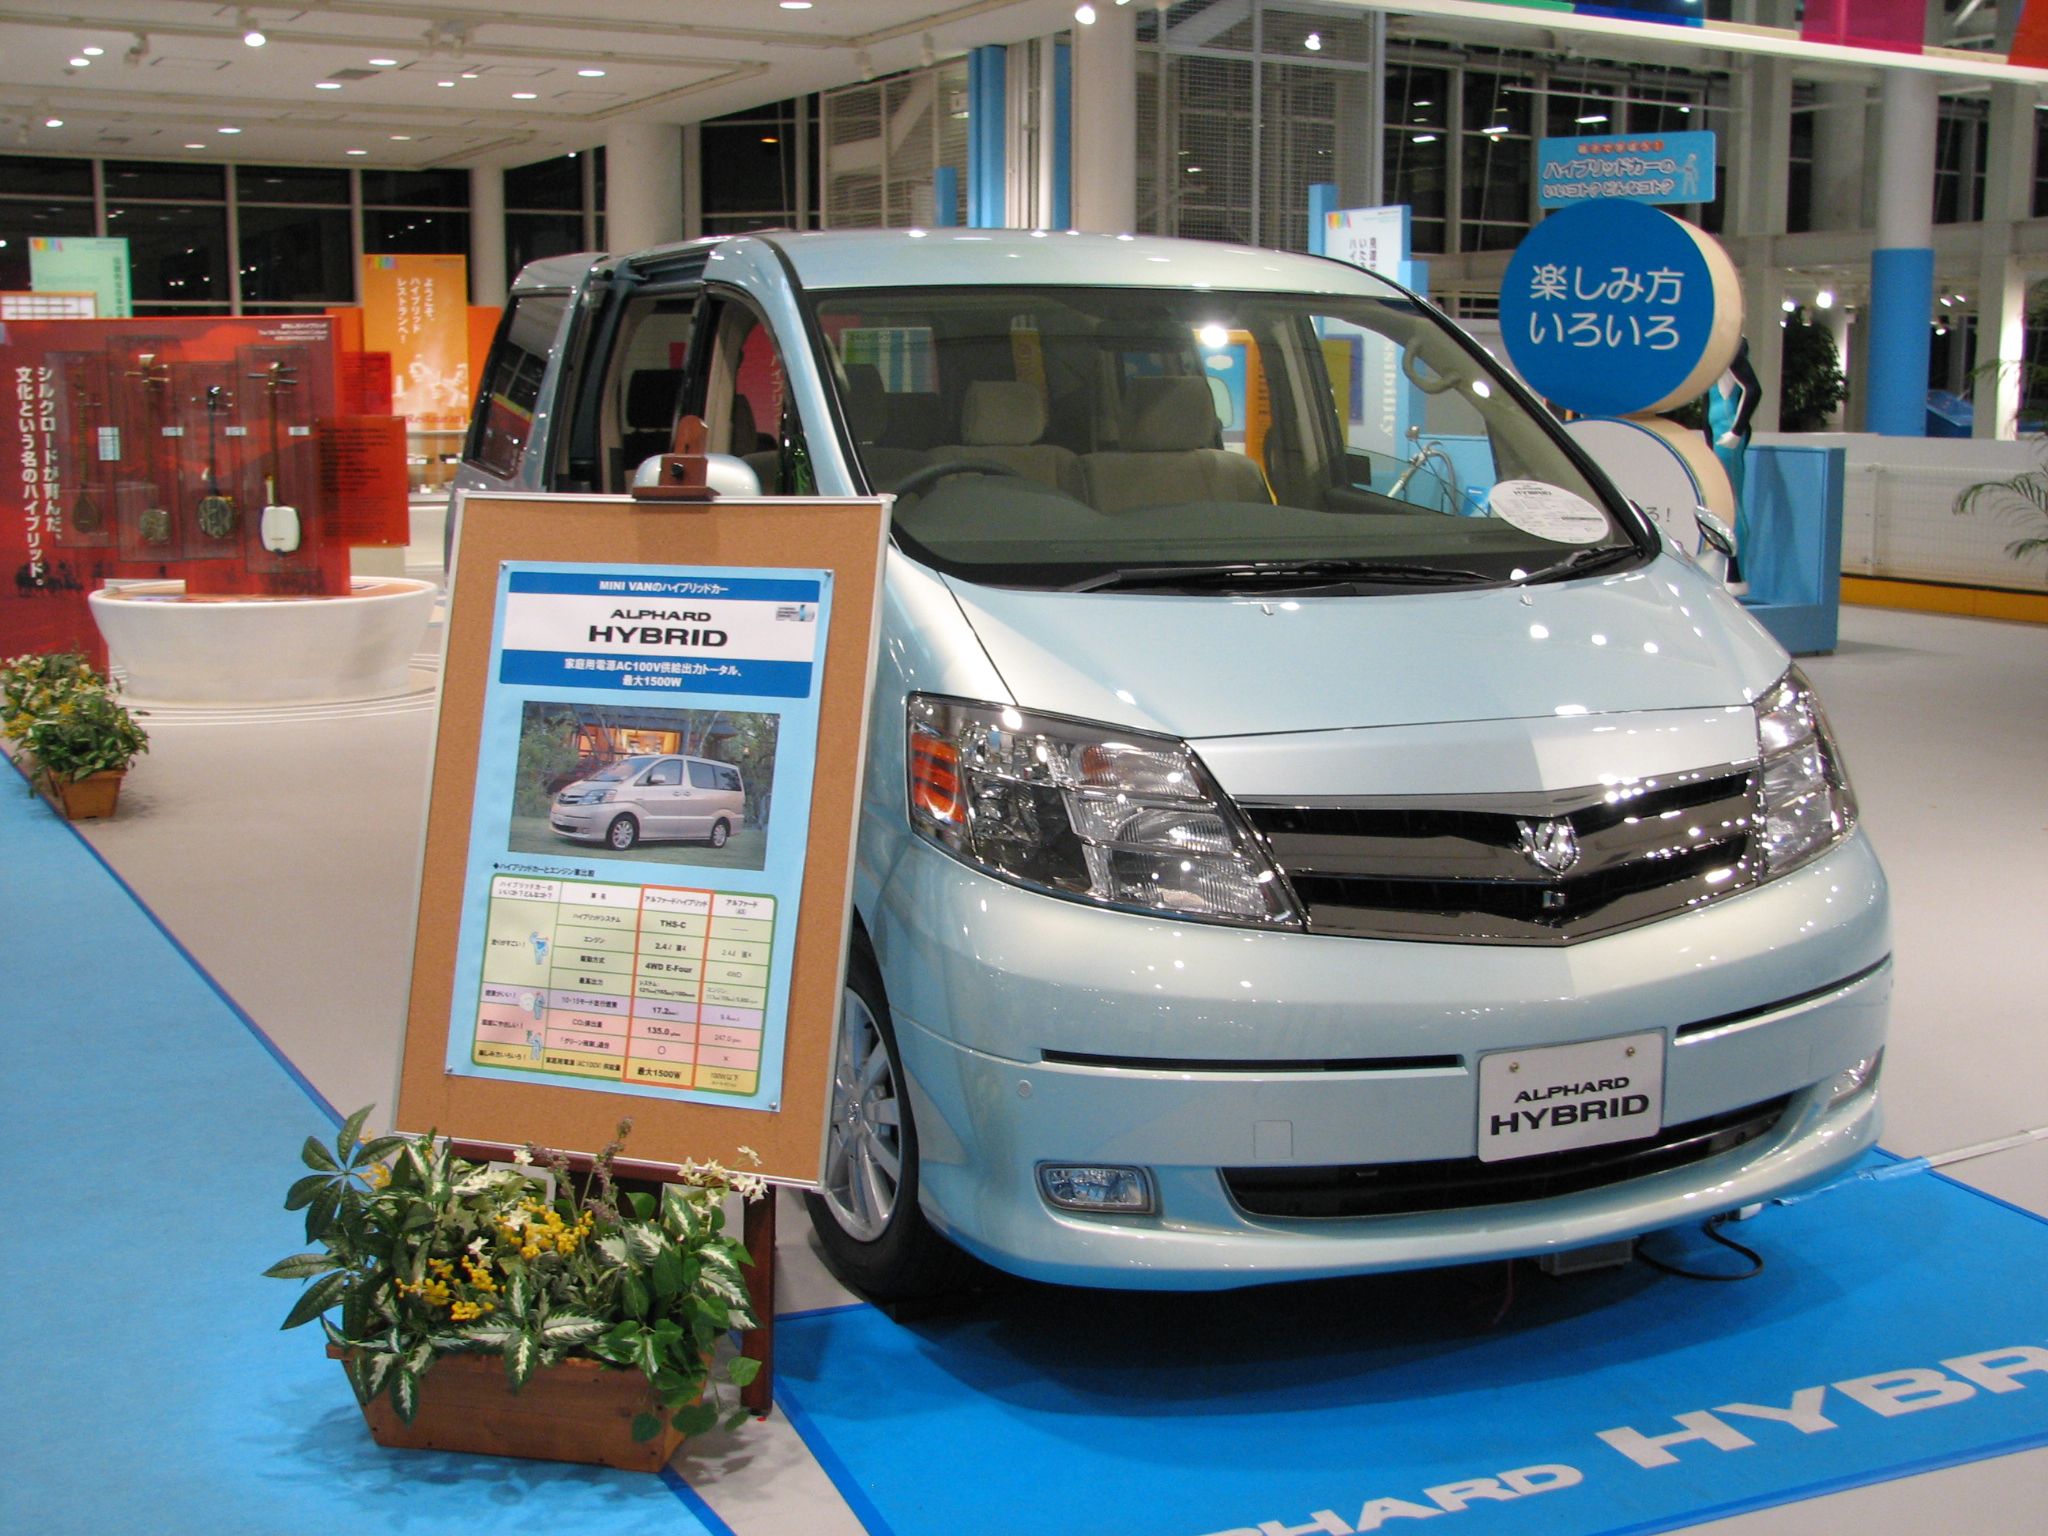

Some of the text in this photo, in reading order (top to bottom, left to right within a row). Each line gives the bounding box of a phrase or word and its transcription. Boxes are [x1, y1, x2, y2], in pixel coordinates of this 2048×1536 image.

[1543, 157, 1676, 179] ハイブリッドカーの
[1529, 263, 1685, 305] 楽しみ方
[1529, 311, 1680, 350] いろいろ
[37, 366, 62, 540] シルクロードが育んだ、
[16, 367, 44, 586] 文化という名のハイブリッド。
[599, 580, 729, 594] MINI VANのハイブリッドカー
[610, 608, 712, 622] ALPHARD
[588, 625, 728, 647] HYBRID
[564, 657, 742, 677] 家庭用電源AC100V供給出力トータル、
[622, 675, 682, 688] 最大1500W
[660, 919, 687, 929] THS-C
[645, 962, 693, 974] 4WD E-Four
[637, 1066, 682, 1079] 最大1500W
[1514, 1077, 1630, 1103] ALPHARD
[1490, 1094, 1649, 1135] HYBRID
[1200, 1464, 1584, 1536] HARD
